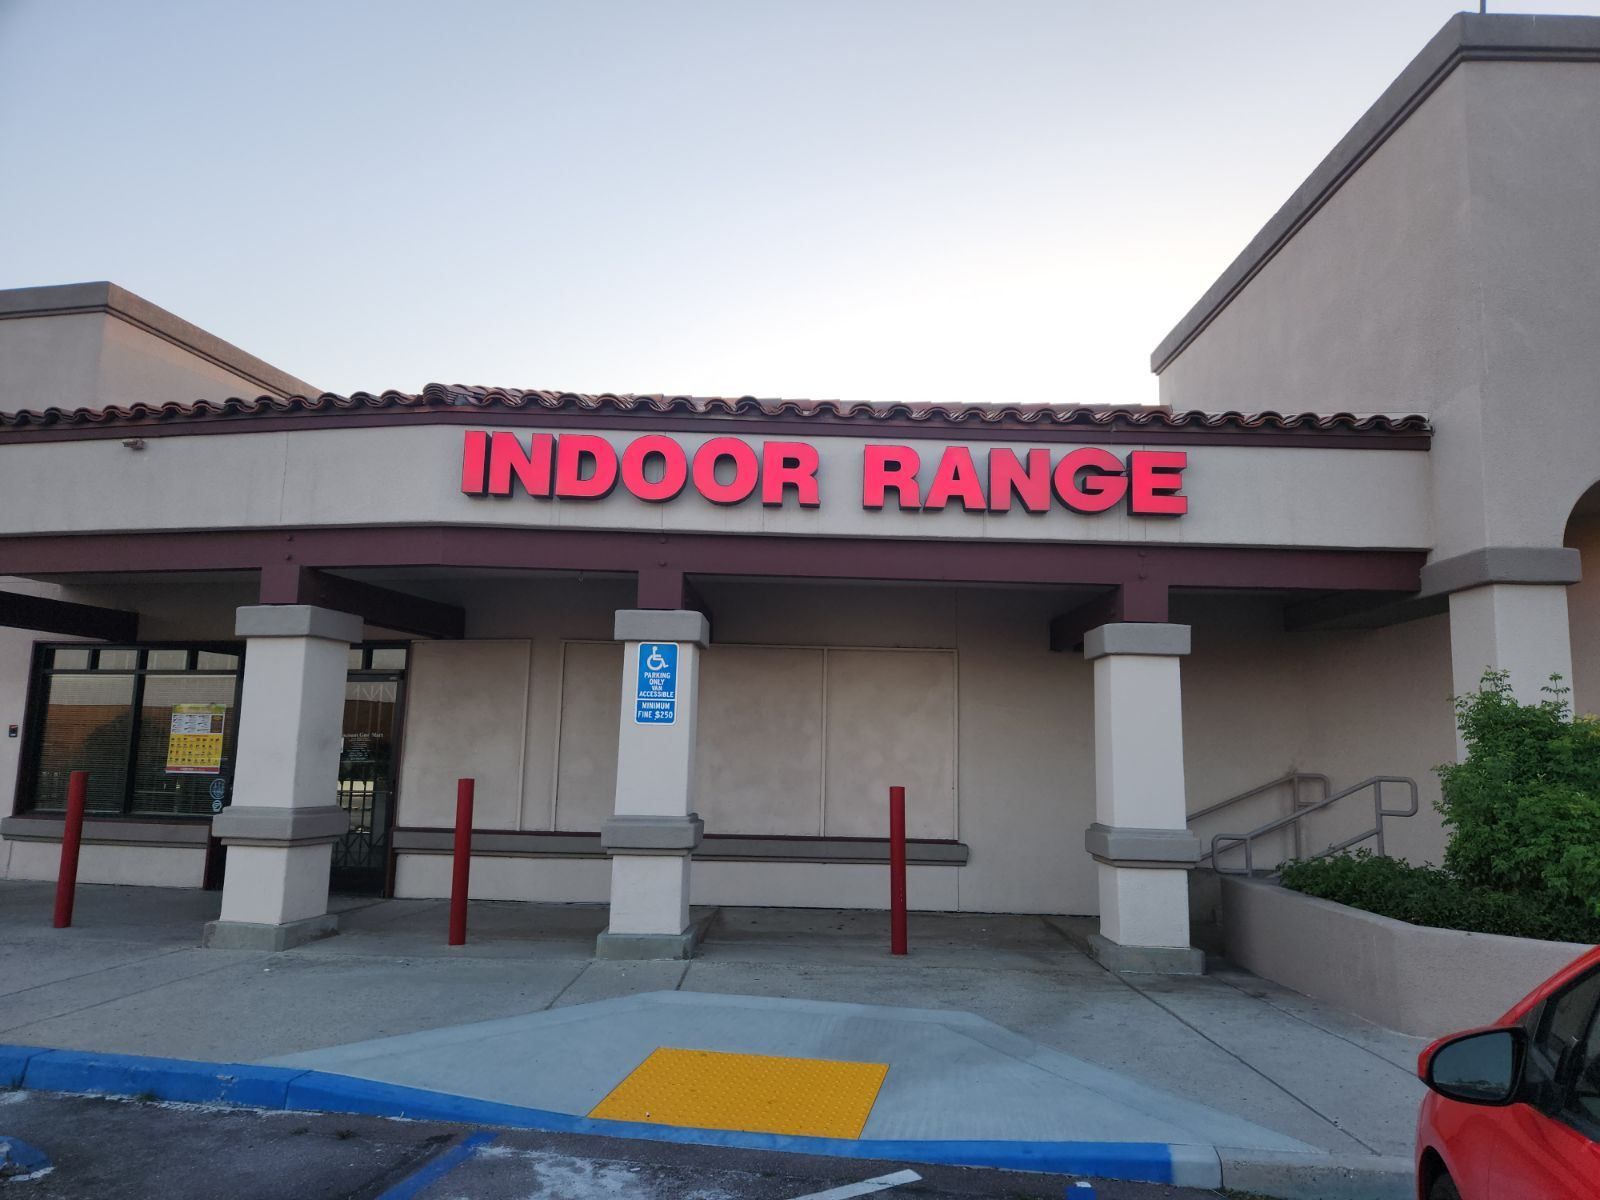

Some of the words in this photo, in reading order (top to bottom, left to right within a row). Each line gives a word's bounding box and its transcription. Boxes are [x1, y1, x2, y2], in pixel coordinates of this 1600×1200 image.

[461, 430, 820, 507] INDOOR
[863, 444, 1188, 516] RANGE
[654, 711, 673, 719] $250
